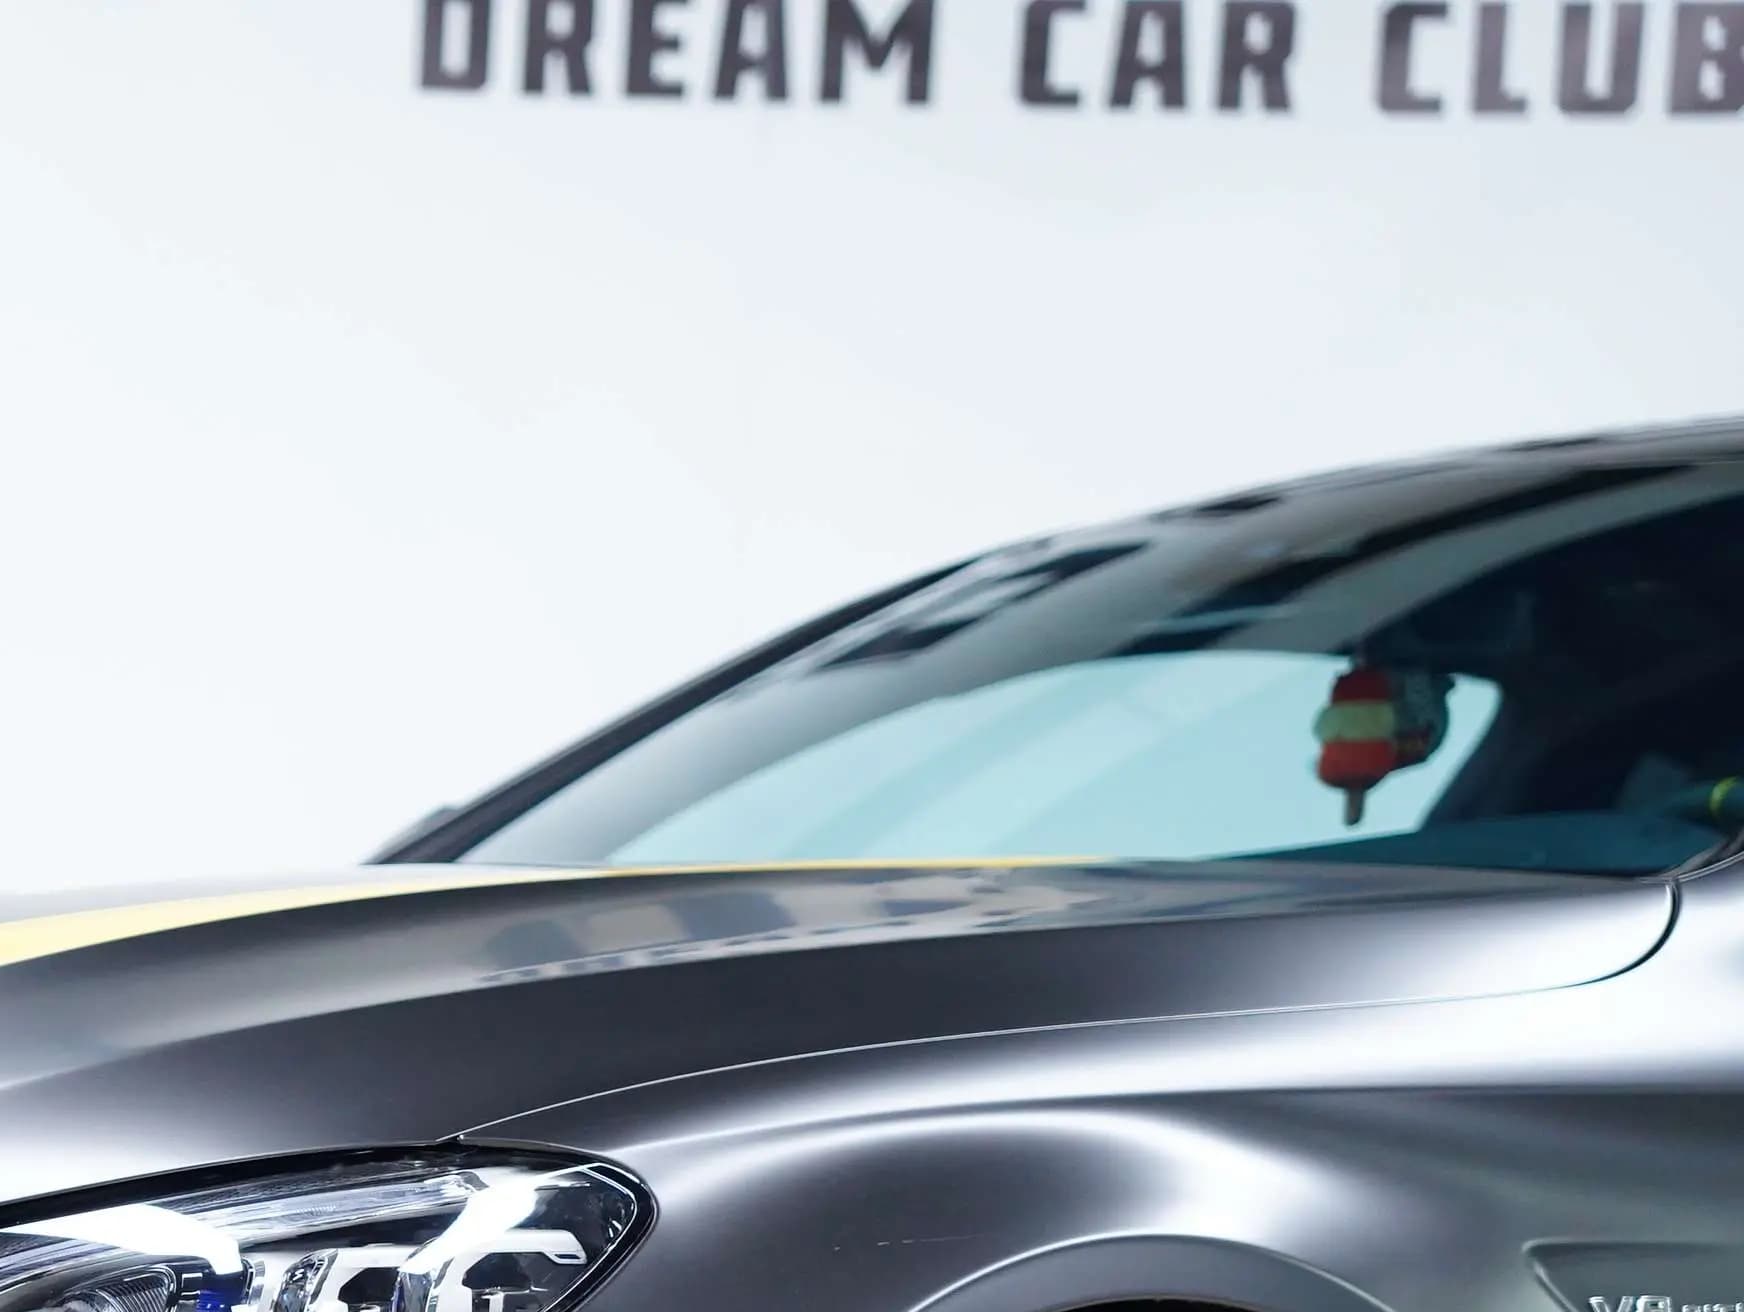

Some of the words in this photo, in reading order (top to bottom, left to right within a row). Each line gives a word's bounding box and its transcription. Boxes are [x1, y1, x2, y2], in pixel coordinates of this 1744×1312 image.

[418, 0, 936, 104] DREAM
[1017, 0, 1295, 112] CAR
[1375, 0, 1744, 115] CLUB
